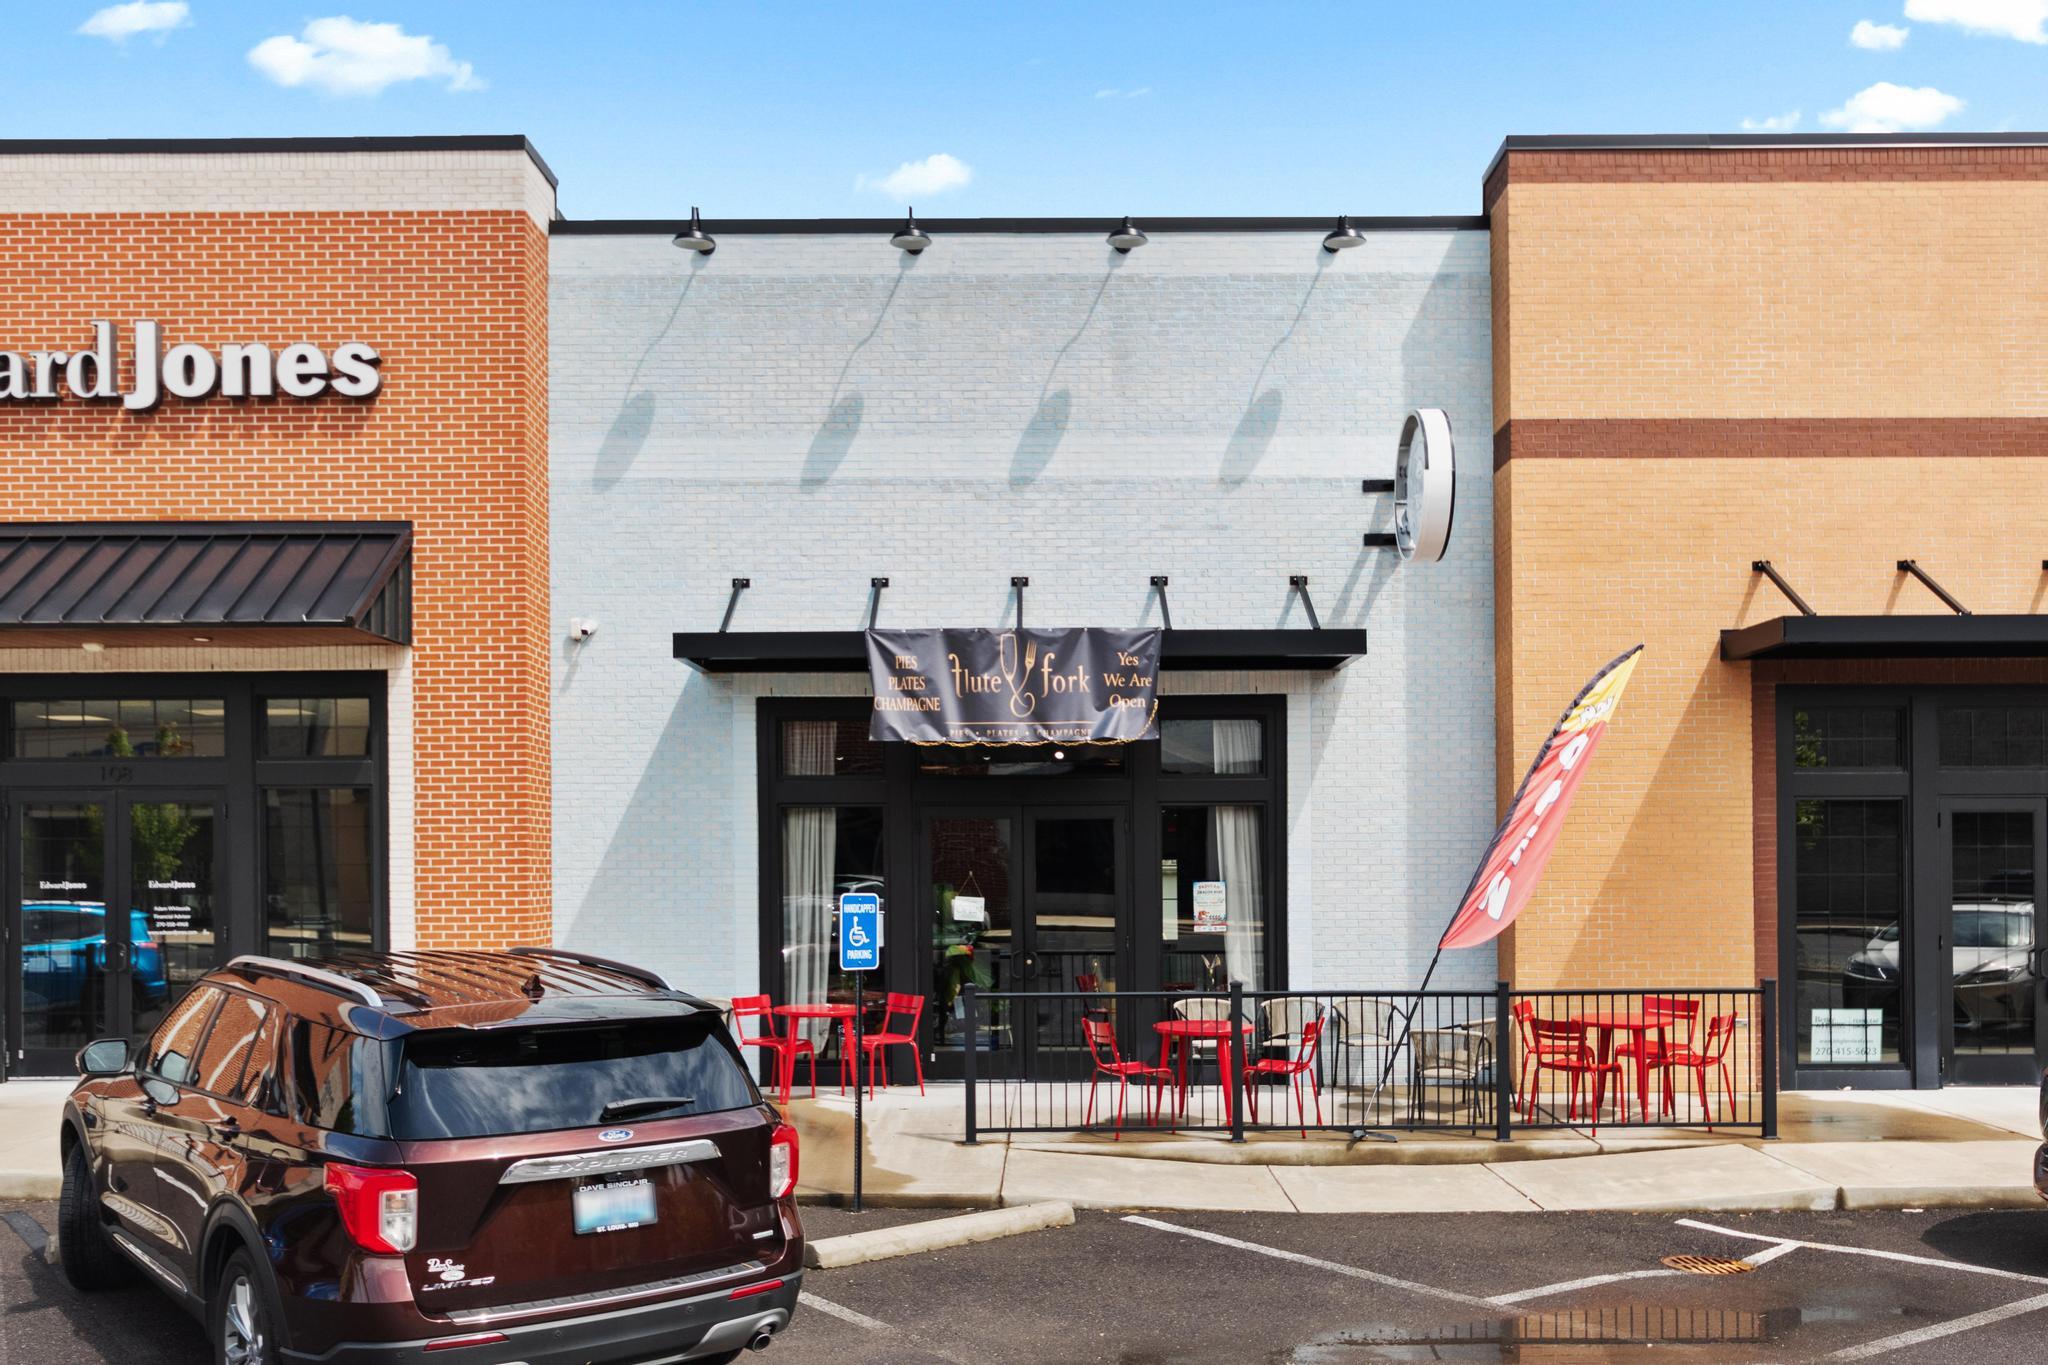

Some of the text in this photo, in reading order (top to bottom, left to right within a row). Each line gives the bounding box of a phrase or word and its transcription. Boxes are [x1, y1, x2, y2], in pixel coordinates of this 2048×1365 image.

[895, 655, 918, 670] PIES
[1117, 651, 1139, 666] Yes
[888, 675, 926, 691] PLATES
[947, 652, 1002, 699] flute
[1040, 652, 1091, 698] fork
[1103, 672, 1153, 688] We Are
[874, 695, 941, 712] CHAMPAGNE
[1109, 693, 1146, 712] Open
[986, 729, 1018, 738] PLATES
[843, 903, 876, 914] HANDICAPPED
[847, 949, 872, 960] PARKING
[543, 1150, 689, 1175] EXPLORER
[579, 1178, 652, 1193] DAVE SINCLAIR
[421, 1276, 496, 1291] LIMITED
